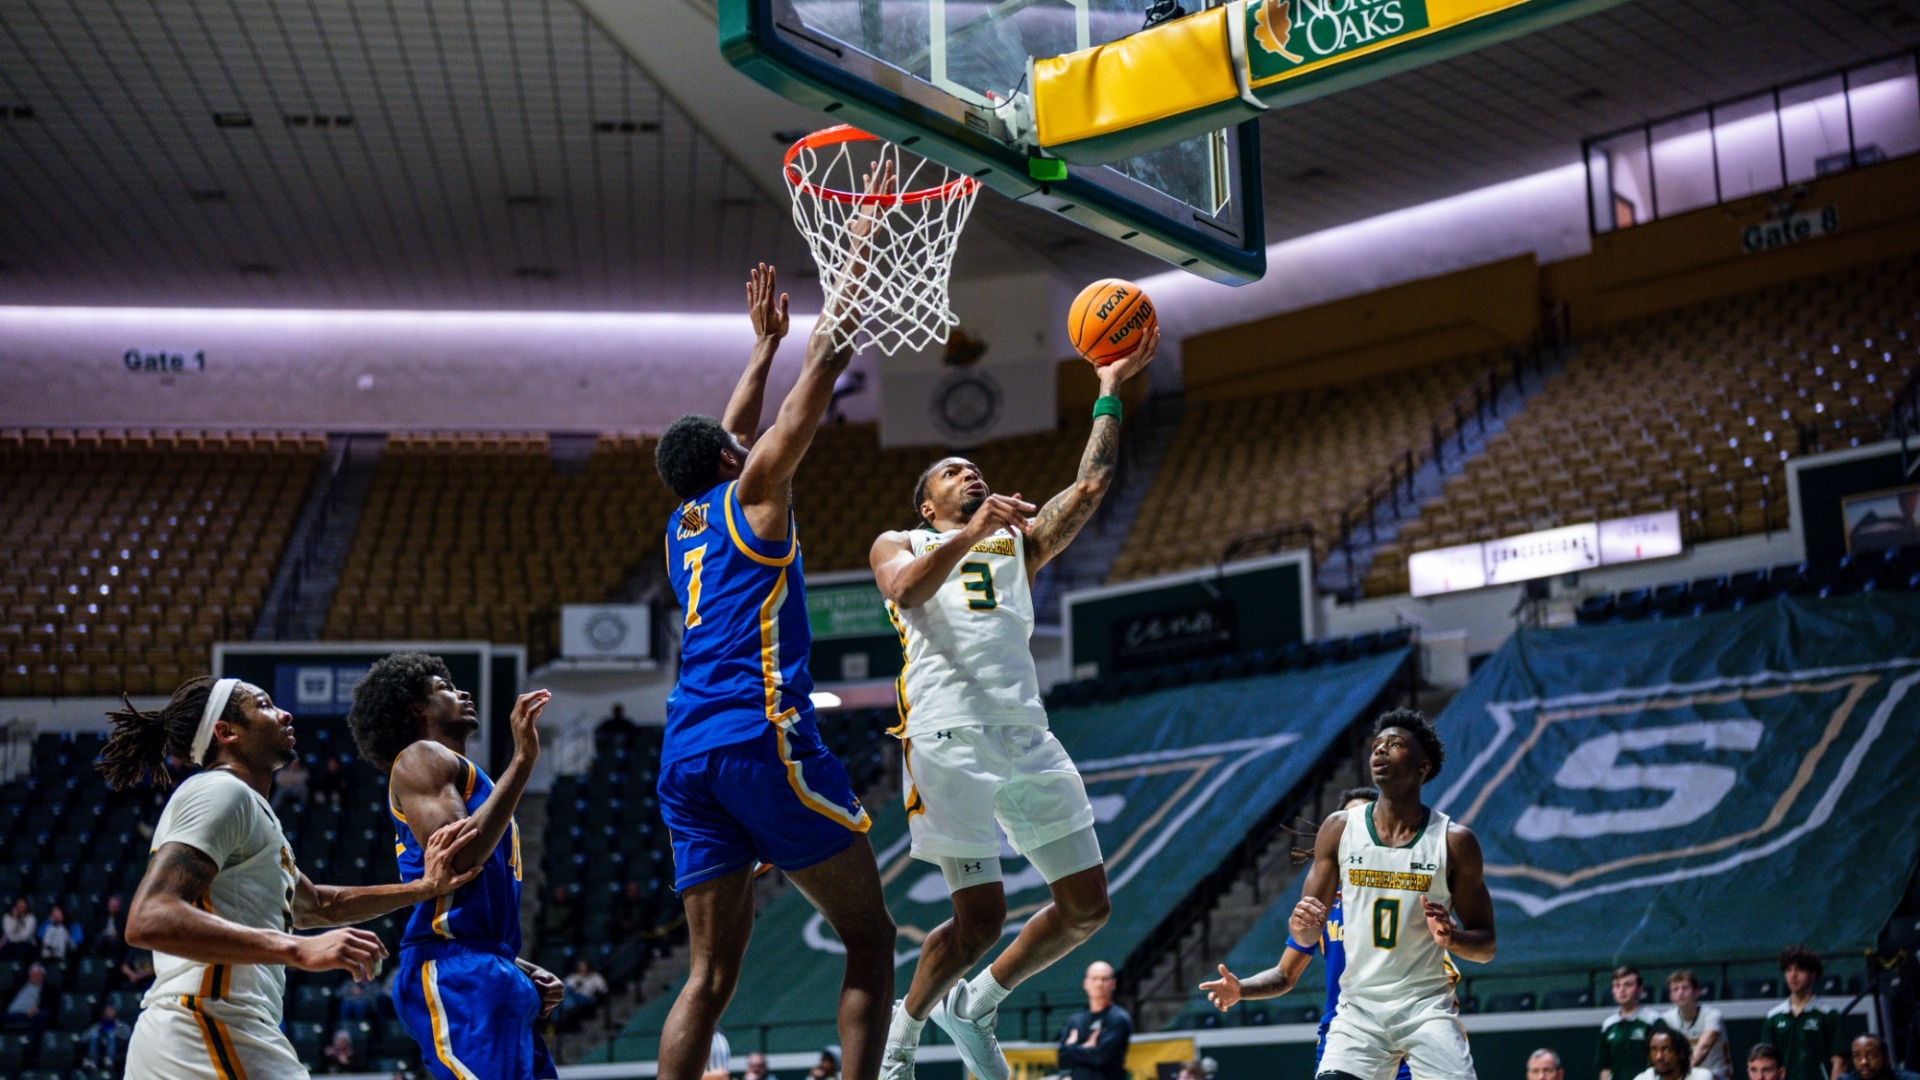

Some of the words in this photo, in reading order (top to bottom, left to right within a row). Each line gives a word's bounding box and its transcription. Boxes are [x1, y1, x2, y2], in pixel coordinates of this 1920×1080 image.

[1306, 1, 1405, 55] OAKS
[1742, 218, 1812, 252] Gate
[1096, 287, 1129, 321] NCAA
[1109, 301, 1153, 344] Wilson
[123, 349, 185, 372] Gate
[194, 350, 205, 372] 1
[1491, 535, 1591, 564] CONCESSIONS
[683, 541, 709, 631] 7
[960, 560, 998, 611] 3
[1514, 718, 1765, 842] S
[1348, 868, 1433, 893] SOUTHEASTERN
[1410, 862, 1437, 871] SLC
[1372, 896, 1401, 951] 0
